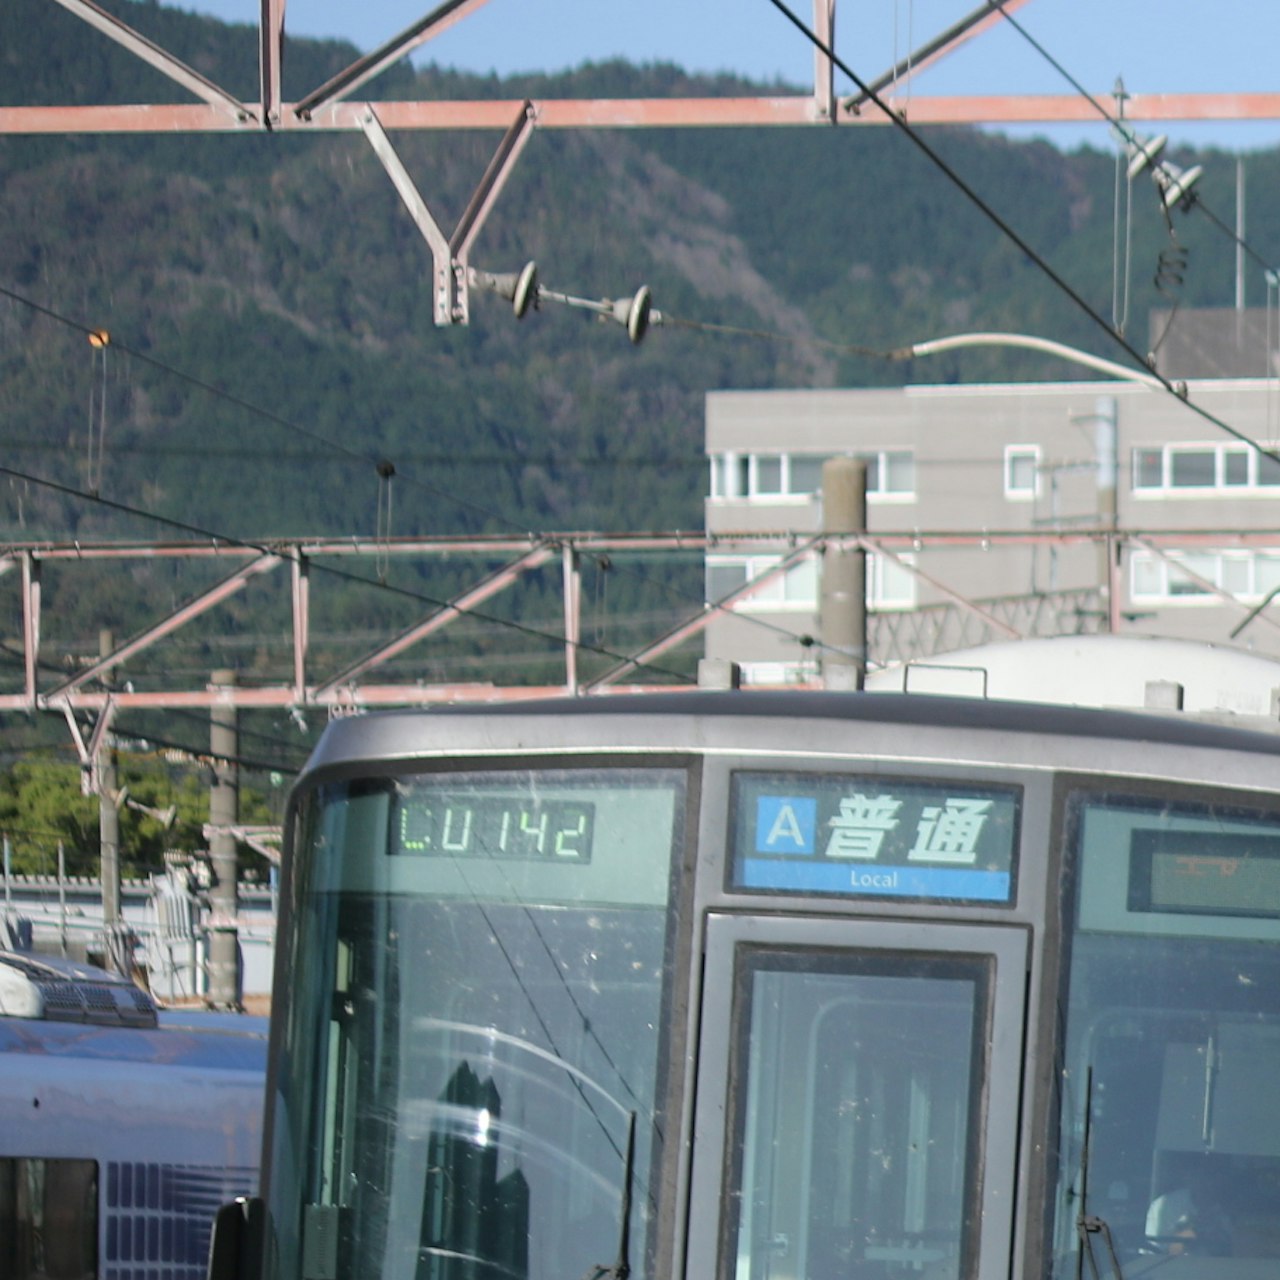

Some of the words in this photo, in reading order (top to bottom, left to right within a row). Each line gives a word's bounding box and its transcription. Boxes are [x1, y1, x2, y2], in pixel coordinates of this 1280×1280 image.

[766, 803, 806, 846] A
[824, 793, 995, 864] 普通
[851, 870, 898, 888] Local
